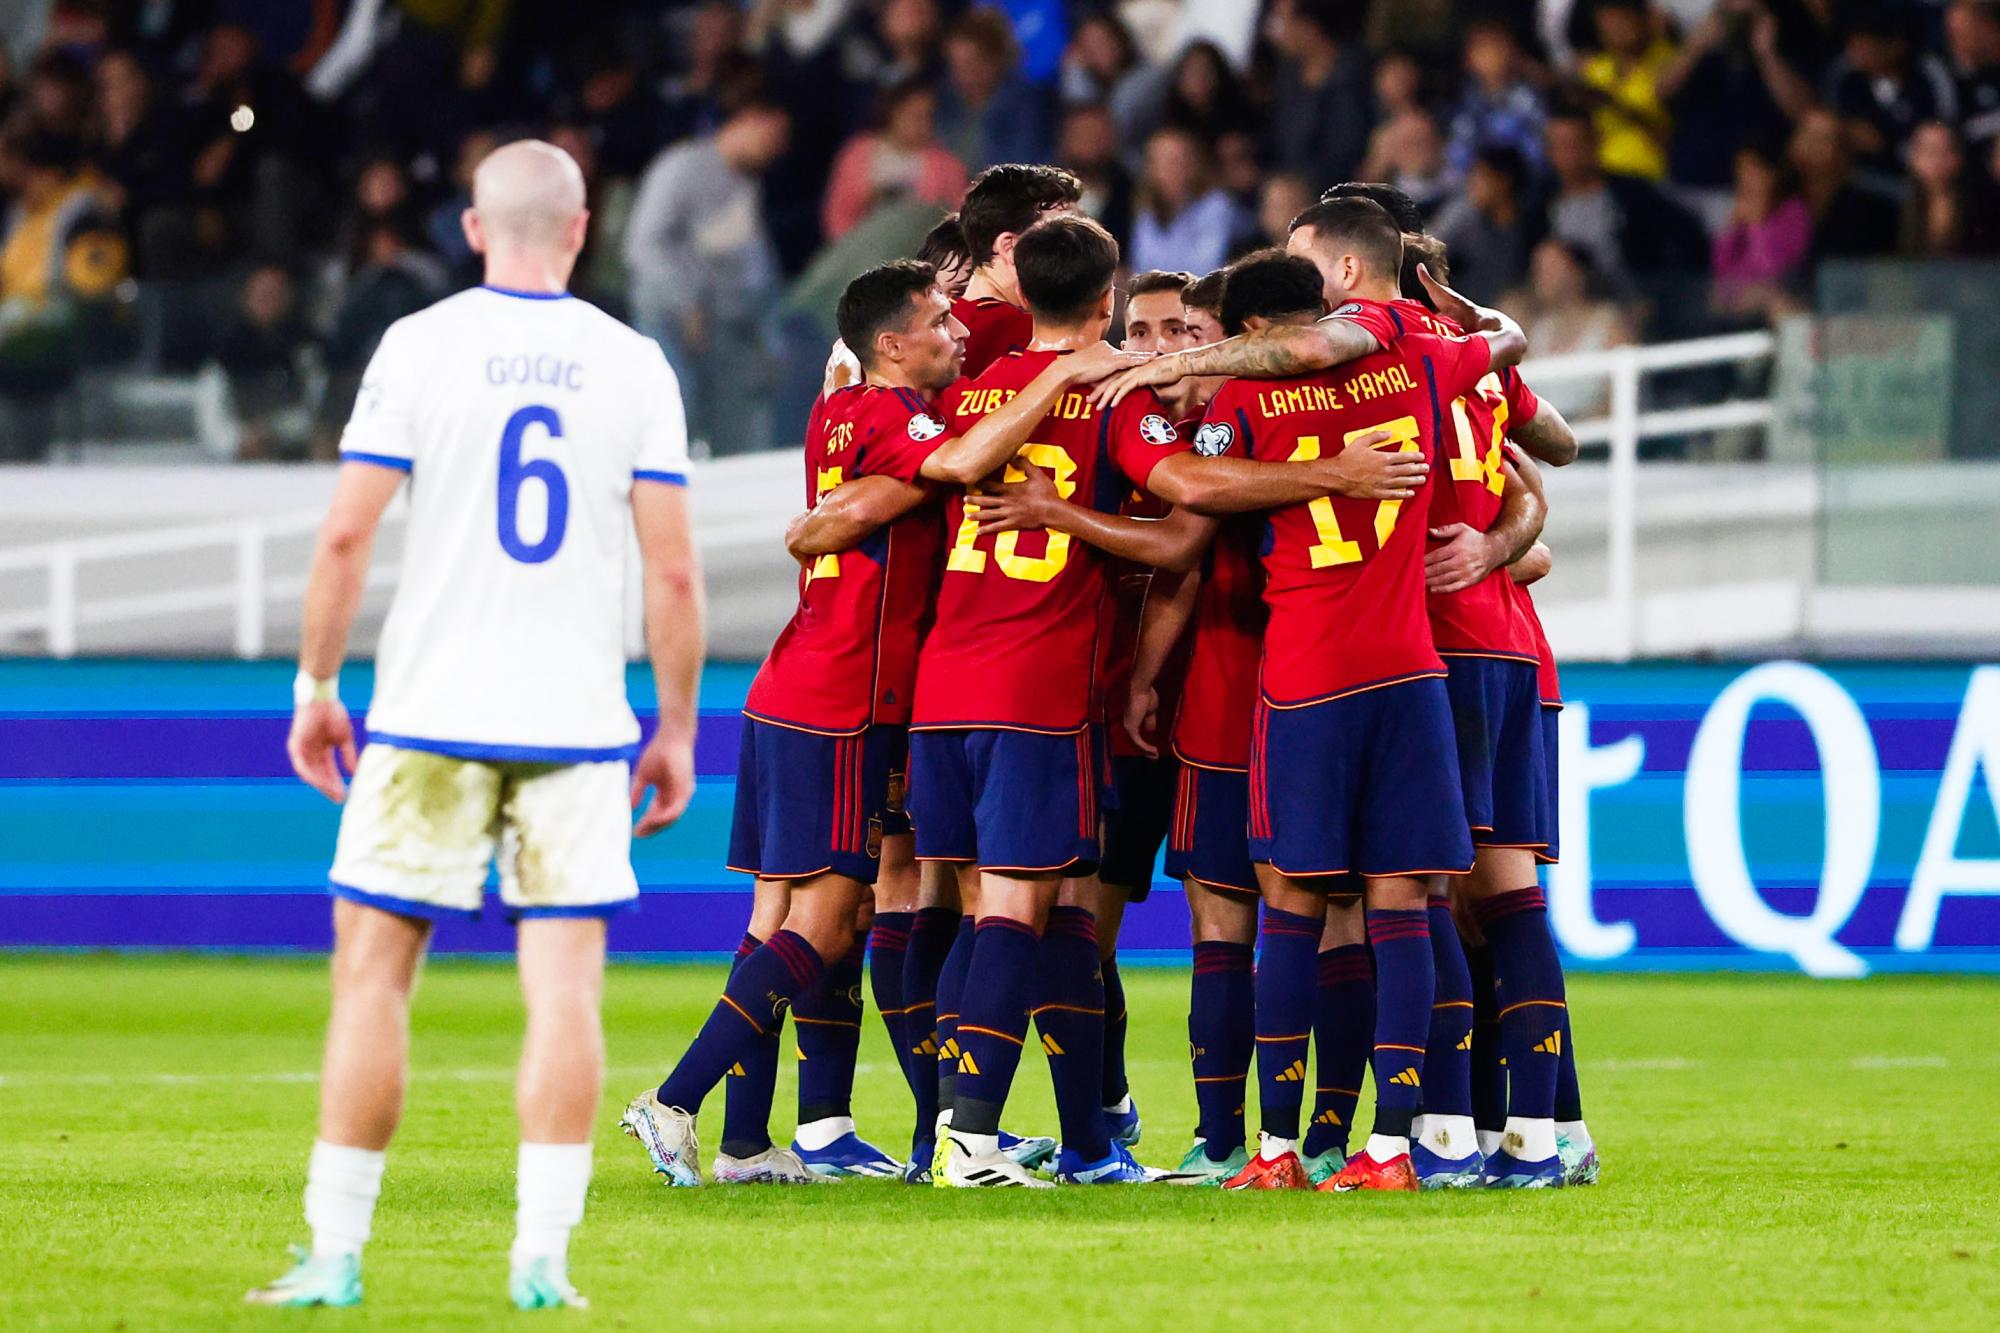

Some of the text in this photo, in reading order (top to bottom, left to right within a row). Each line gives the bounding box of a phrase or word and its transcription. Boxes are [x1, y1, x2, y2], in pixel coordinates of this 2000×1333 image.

[1258, 363, 1418, 418] LAMINE YAMAL
[496, 404, 570, 564] 6
[1287, 415, 1420, 569] 17
